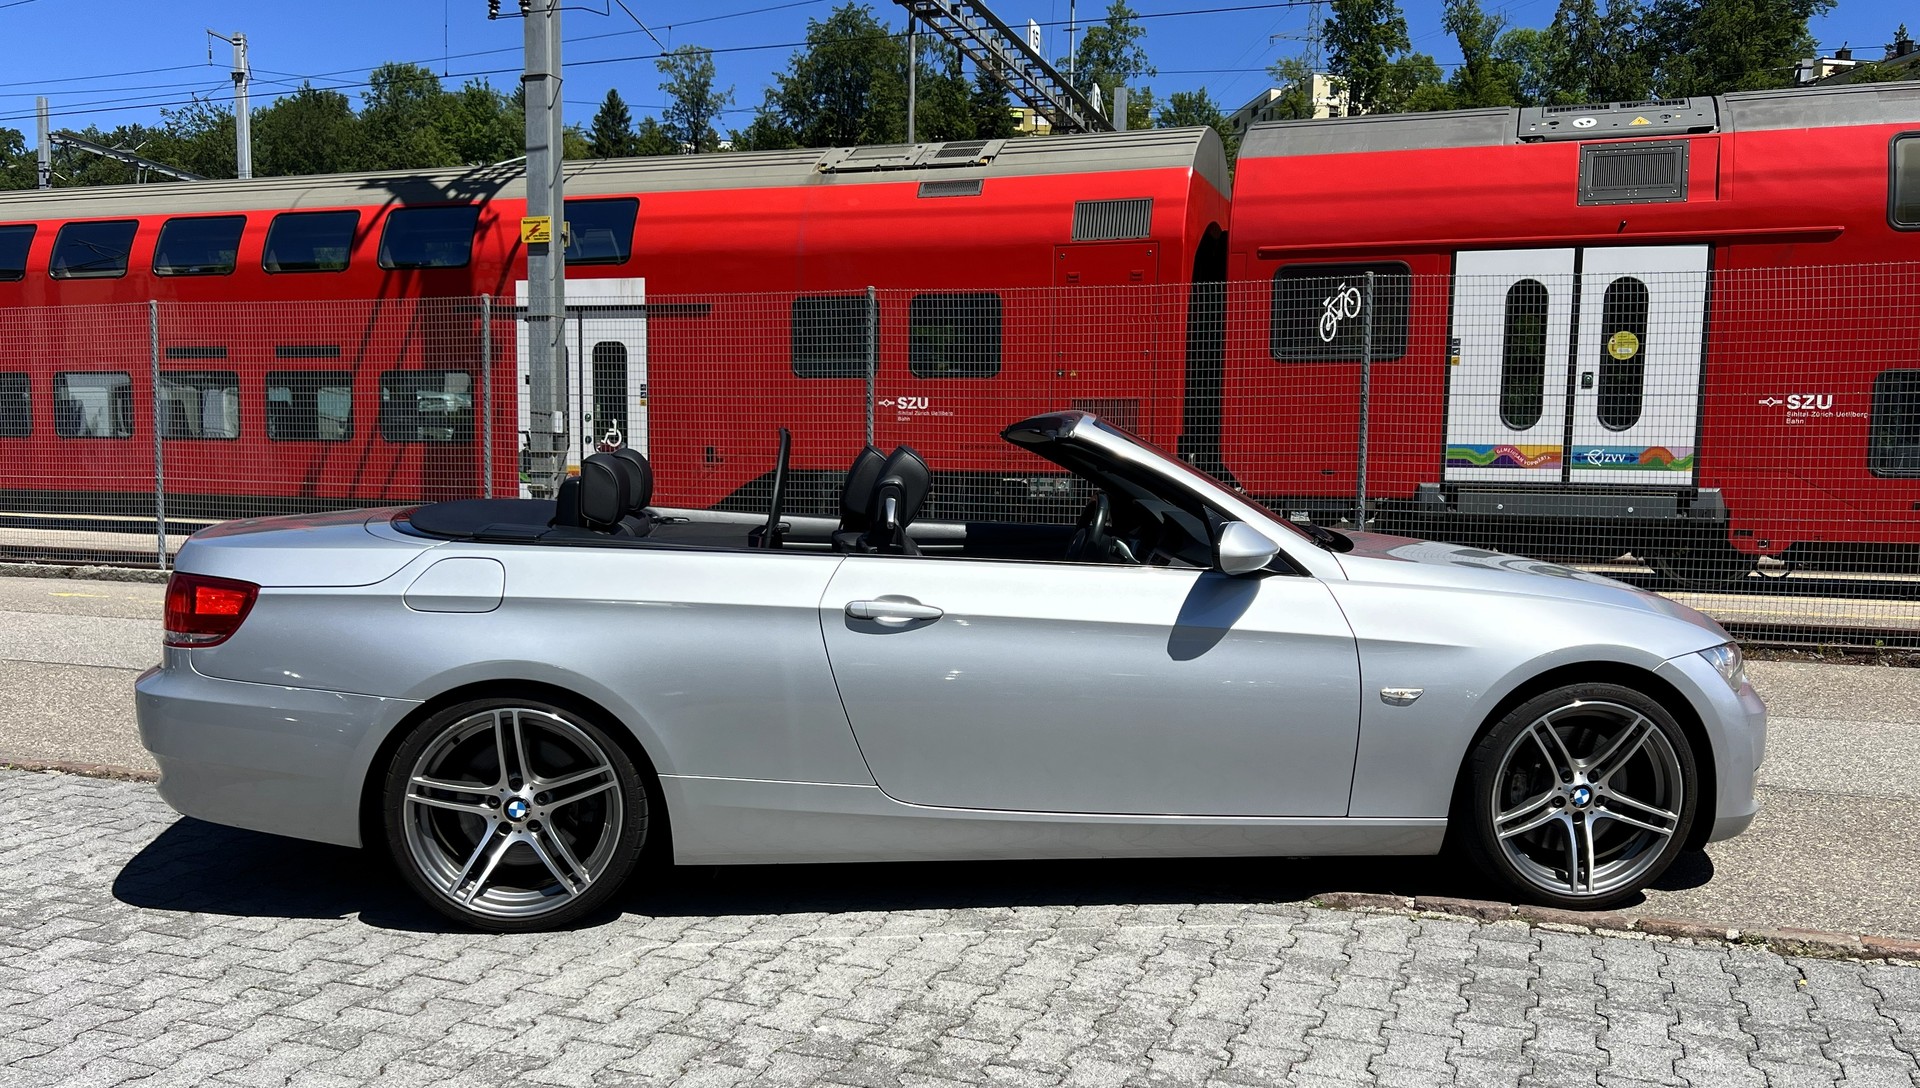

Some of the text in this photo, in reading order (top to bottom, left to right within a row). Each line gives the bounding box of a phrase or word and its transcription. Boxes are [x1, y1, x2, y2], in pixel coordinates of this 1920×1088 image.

[897, 396, 928, 410] SZU
[1787, 394, 1833, 410] SZU
[1604, 454, 1626, 463] ZVV
